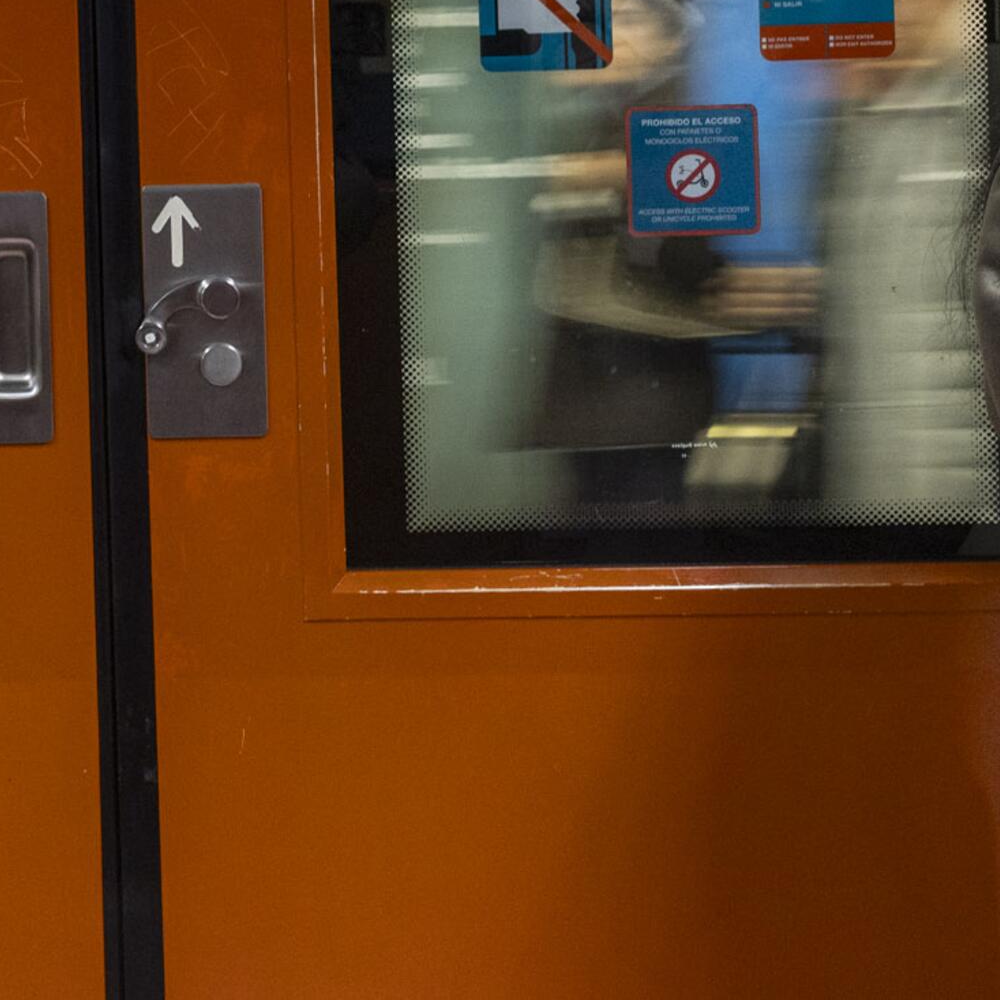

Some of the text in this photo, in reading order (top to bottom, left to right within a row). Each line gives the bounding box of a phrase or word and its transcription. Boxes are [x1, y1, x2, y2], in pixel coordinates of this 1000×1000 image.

[641, 116, 742, 127] PROHIBIDO EL ACCESO
